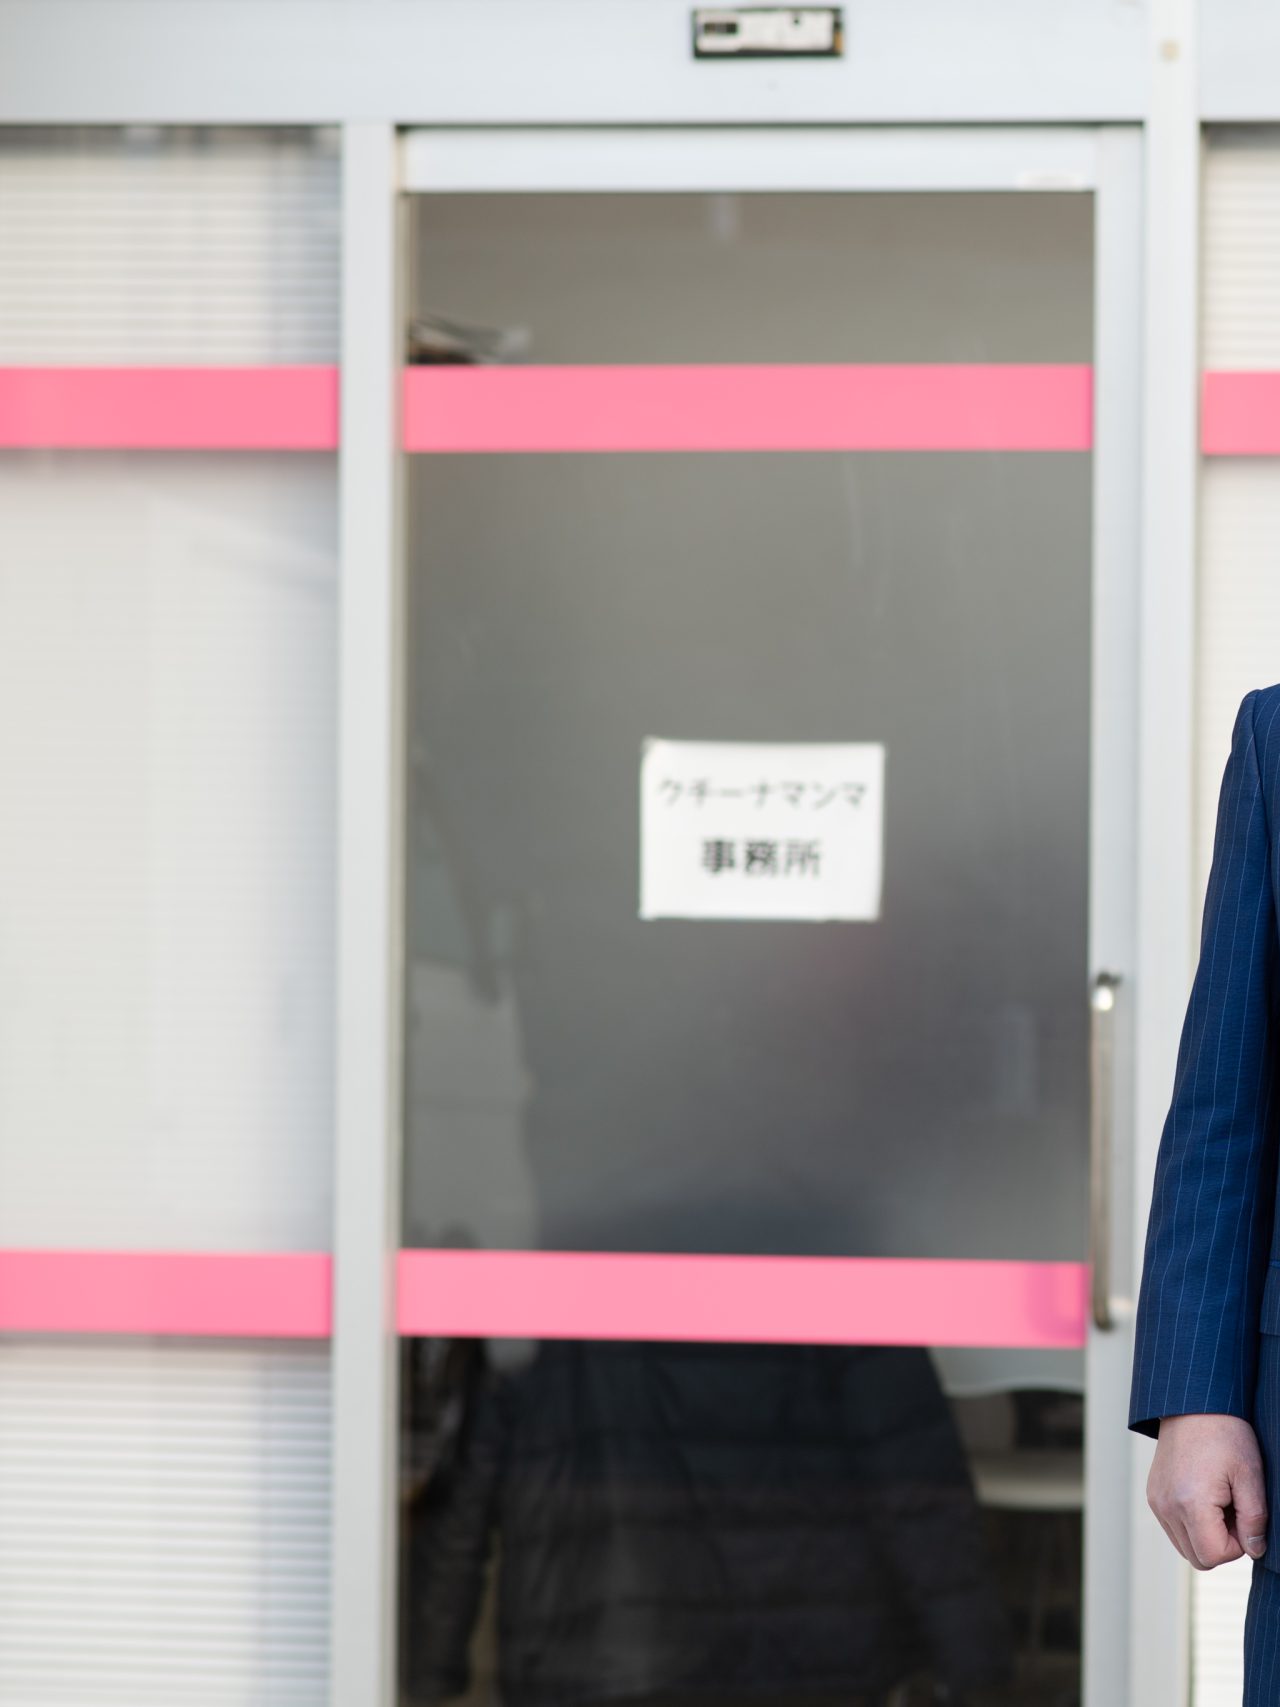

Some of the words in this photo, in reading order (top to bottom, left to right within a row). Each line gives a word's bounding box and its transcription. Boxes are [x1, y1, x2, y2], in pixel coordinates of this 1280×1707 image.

[659, 777, 867, 809] クチーナマンマ
[699, 836, 822, 877] 事務所
